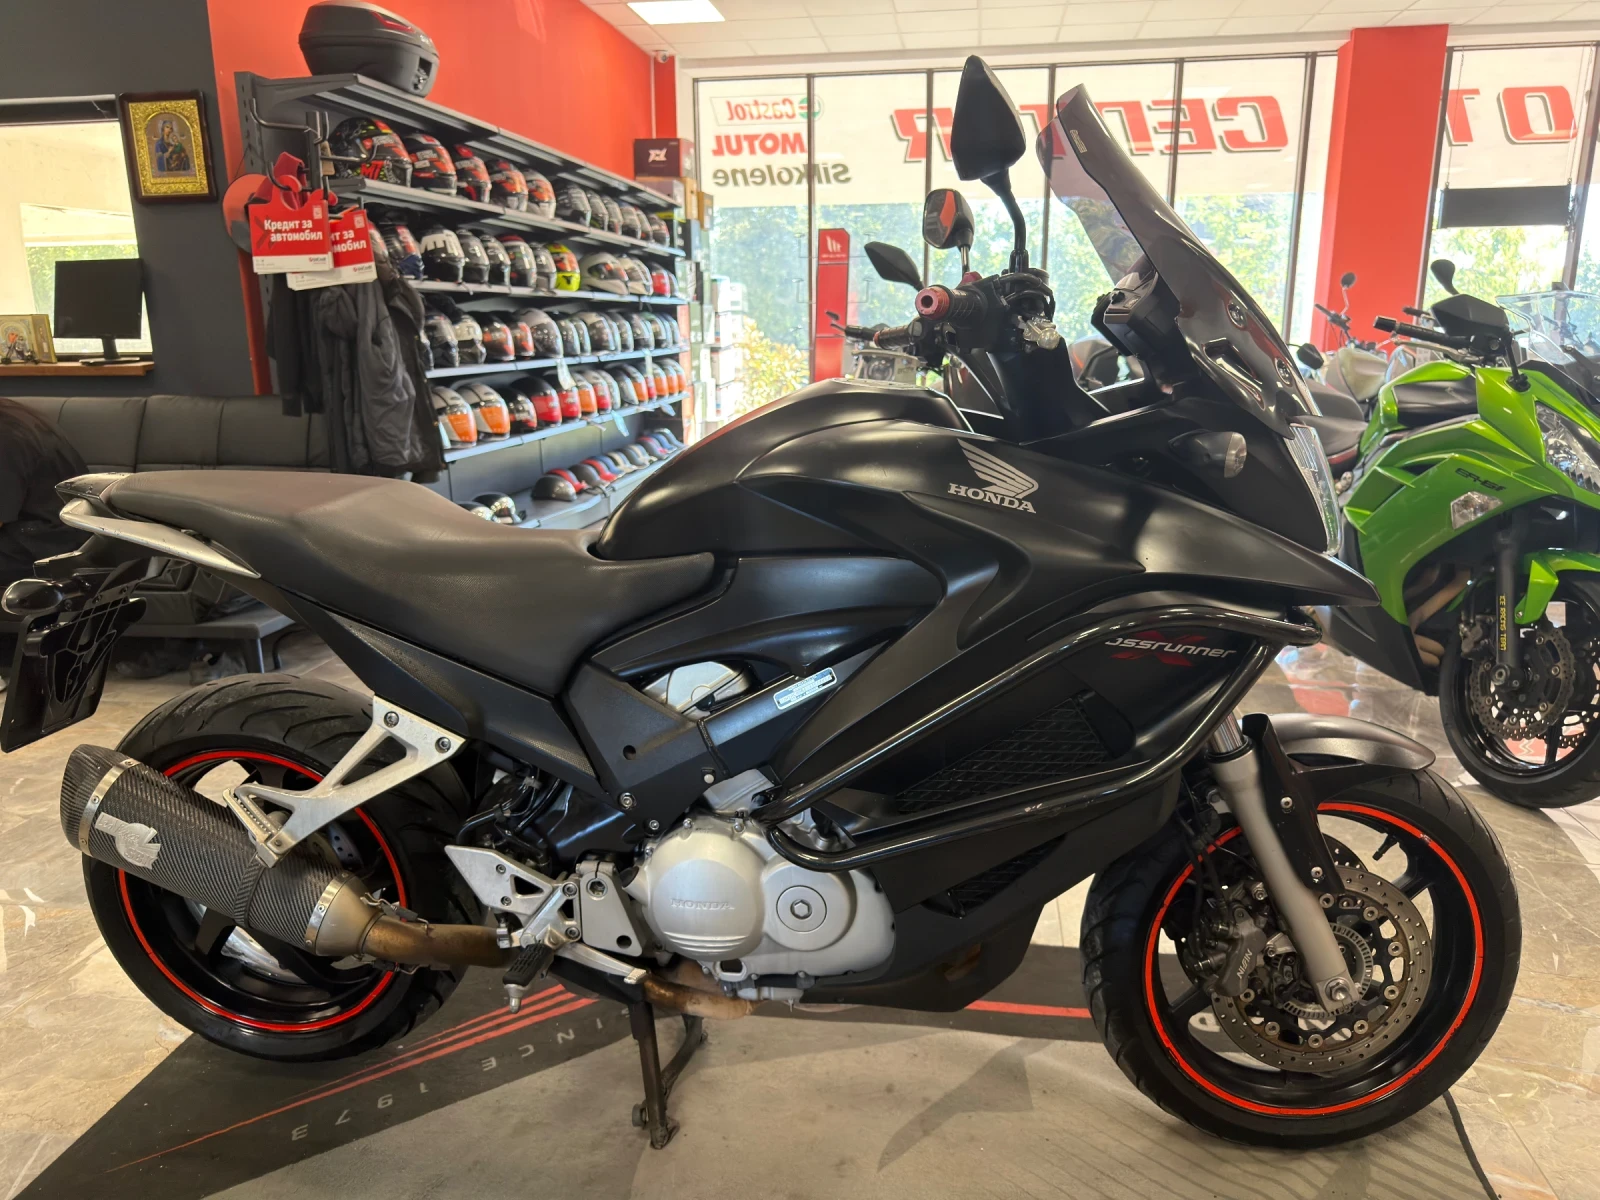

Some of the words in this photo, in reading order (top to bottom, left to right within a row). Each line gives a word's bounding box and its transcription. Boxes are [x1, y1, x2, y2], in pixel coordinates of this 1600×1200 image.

[263, 219, 300, 232] Кредит
[301, 219, 313, 229] за
[270, 229, 324, 242] автомобил
[342, 229, 355, 240] за
[333, 240, 367, 253] мобил
[947, 483, 1037, 514] HONDA
[669, 898, 736, 911] HONDA
[290, 1081, 430, 1142] 1973
